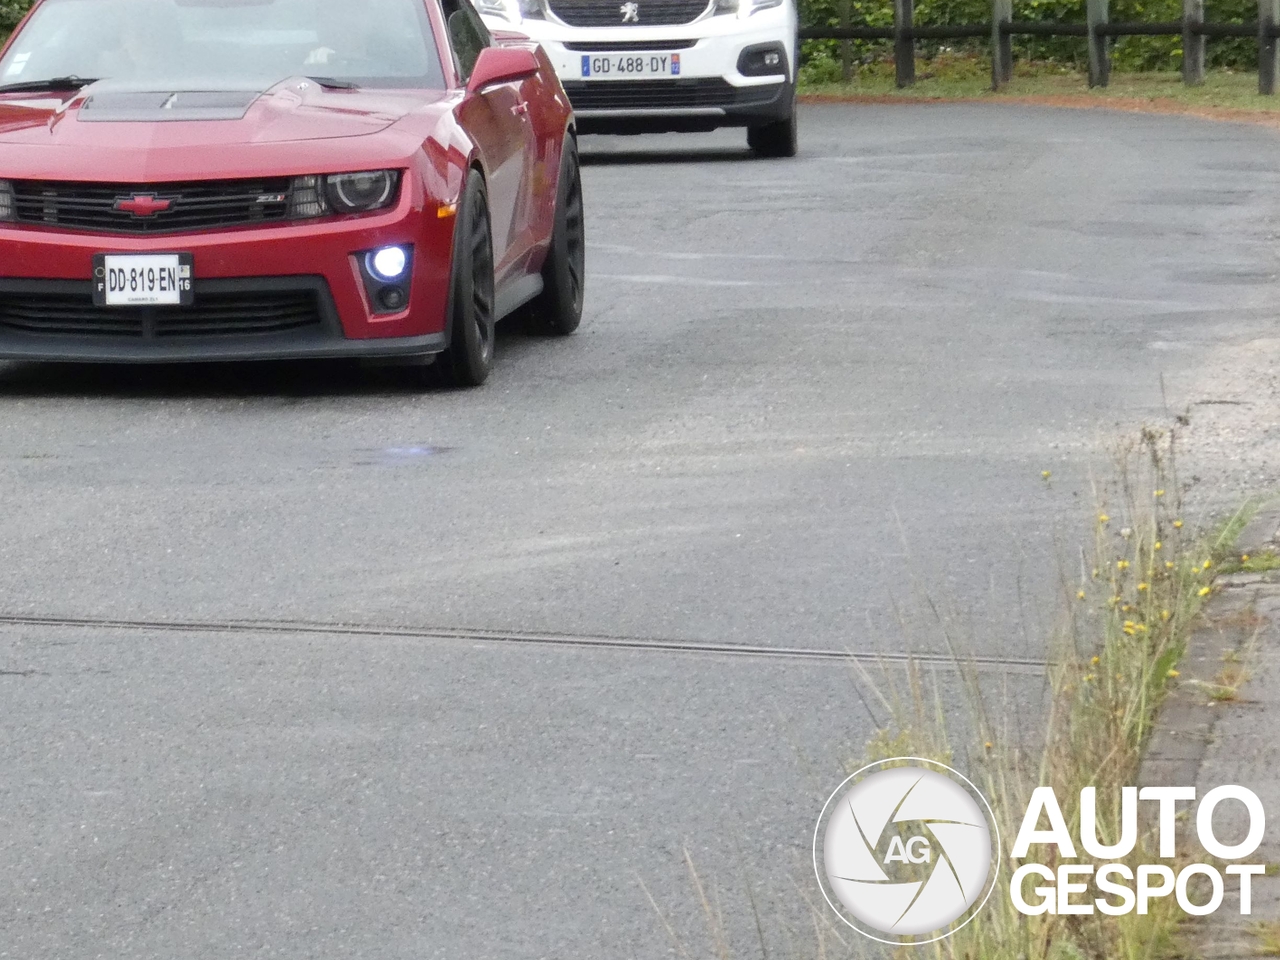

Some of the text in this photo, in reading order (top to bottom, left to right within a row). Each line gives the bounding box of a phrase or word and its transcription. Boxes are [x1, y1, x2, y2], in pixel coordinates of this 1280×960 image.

[593, 56, 667, 73] GD-488-DY
[109, 267, 176, 292] DD-819-EN
[180, 280, 190, 290] 16
[98, 283, 104, 291] F
